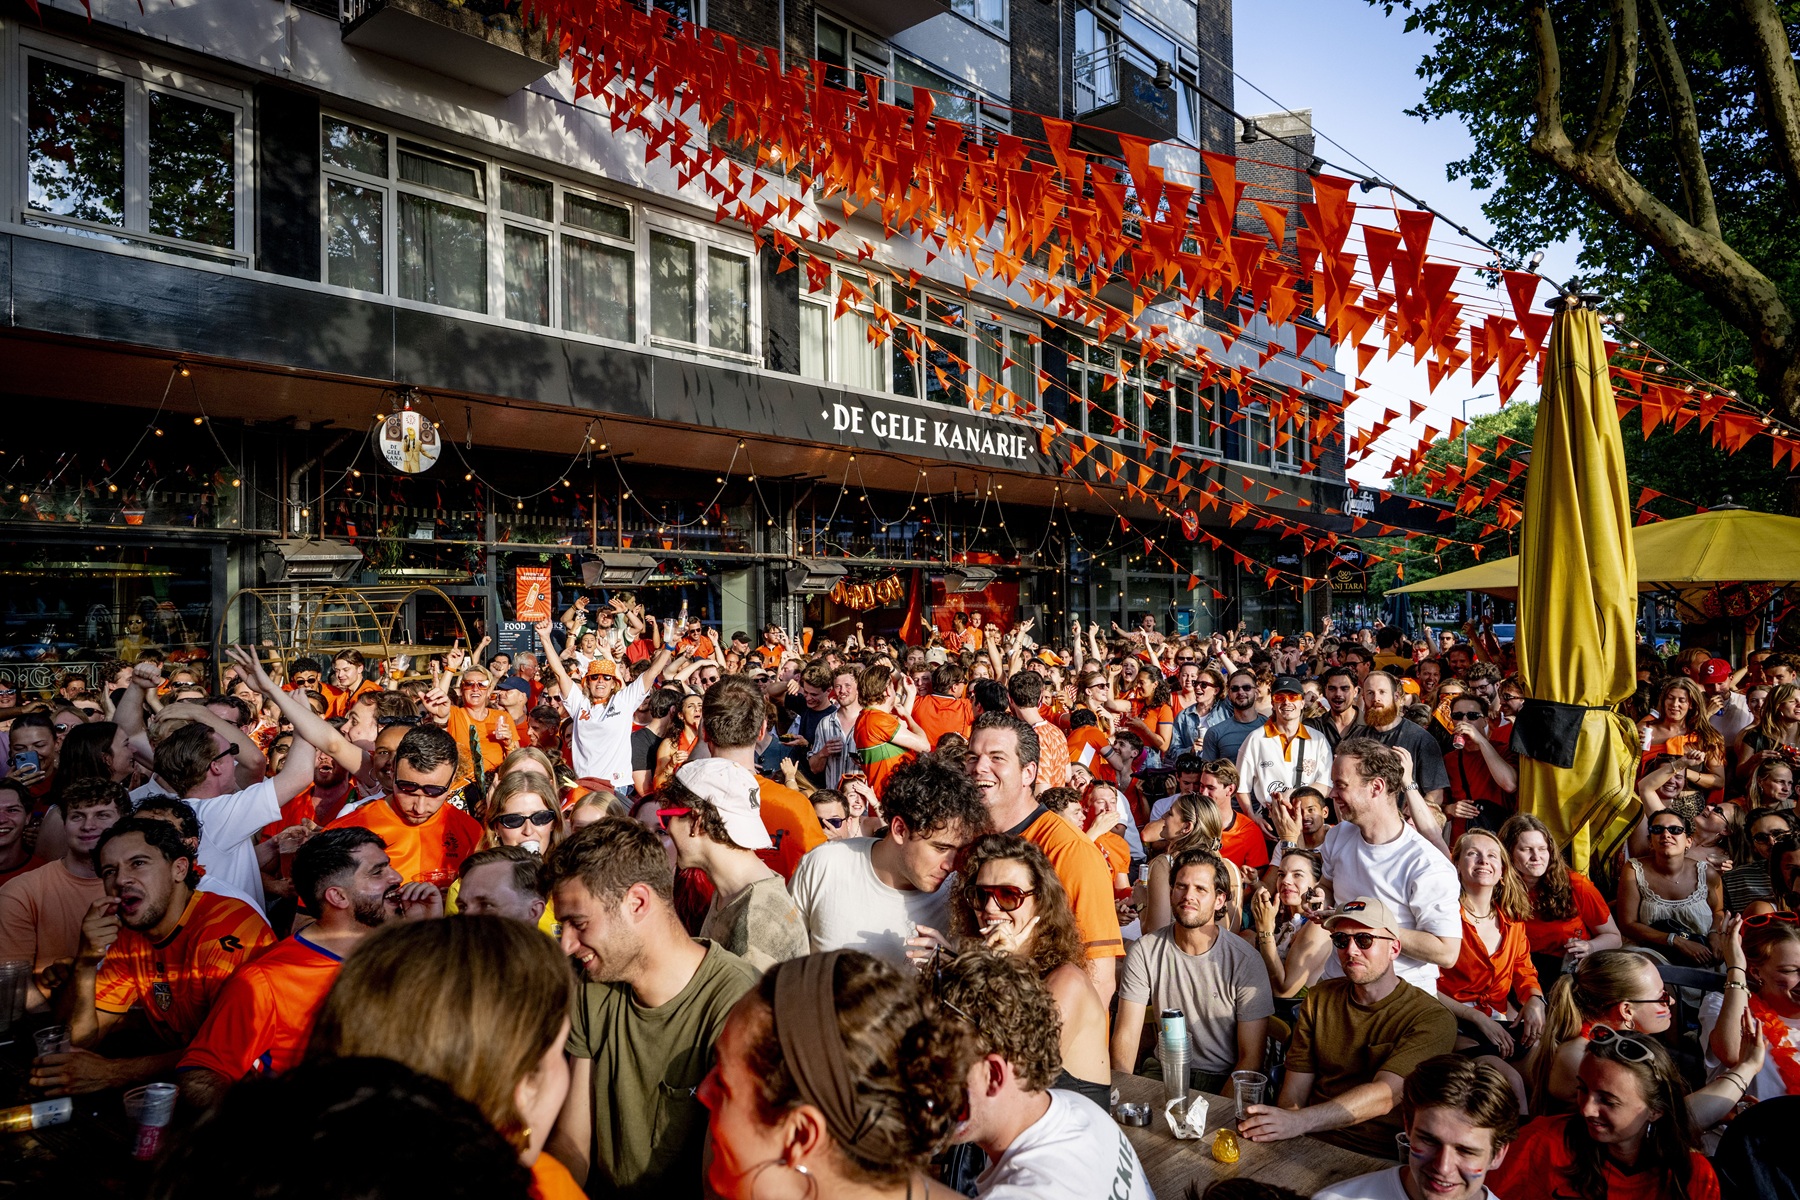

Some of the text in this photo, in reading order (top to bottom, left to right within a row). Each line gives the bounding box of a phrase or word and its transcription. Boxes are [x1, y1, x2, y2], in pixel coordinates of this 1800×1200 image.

[833, 403, 1027, 460] DE GELE KANARIE
